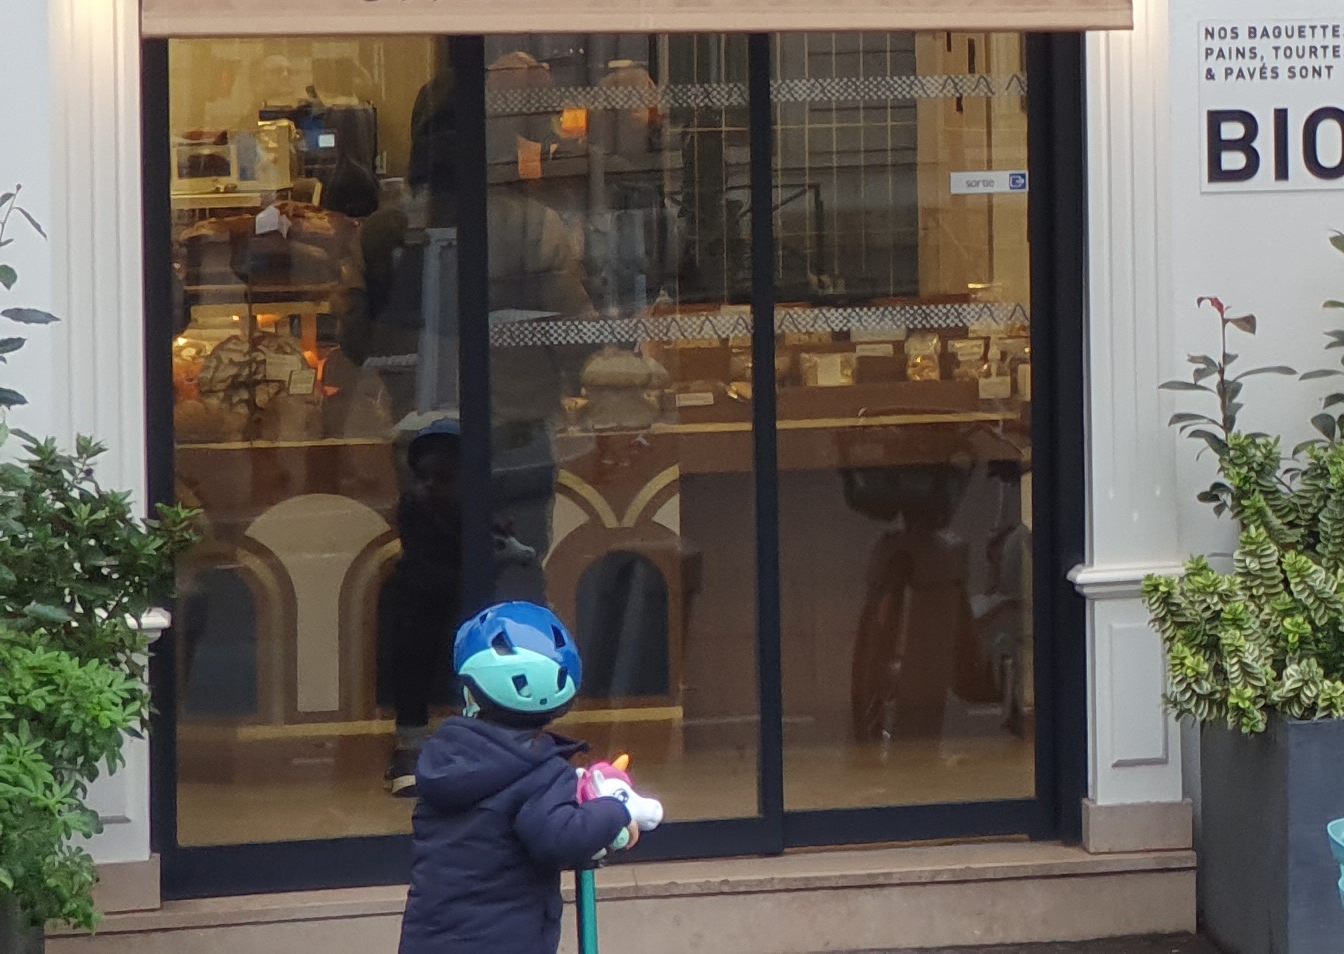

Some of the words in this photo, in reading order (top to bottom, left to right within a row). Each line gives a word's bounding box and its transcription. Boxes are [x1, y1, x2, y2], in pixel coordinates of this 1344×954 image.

[1205, 27, 1239, 40] NOS
[1205, 47, 1264, 62] PAINS,
[1205, 67, 1217, 81] &
[1225, 63, 1279, 80] PAVÉS
[1288, 65, 1333, 79] SONT
[965, 178, 995, 188] sortie
